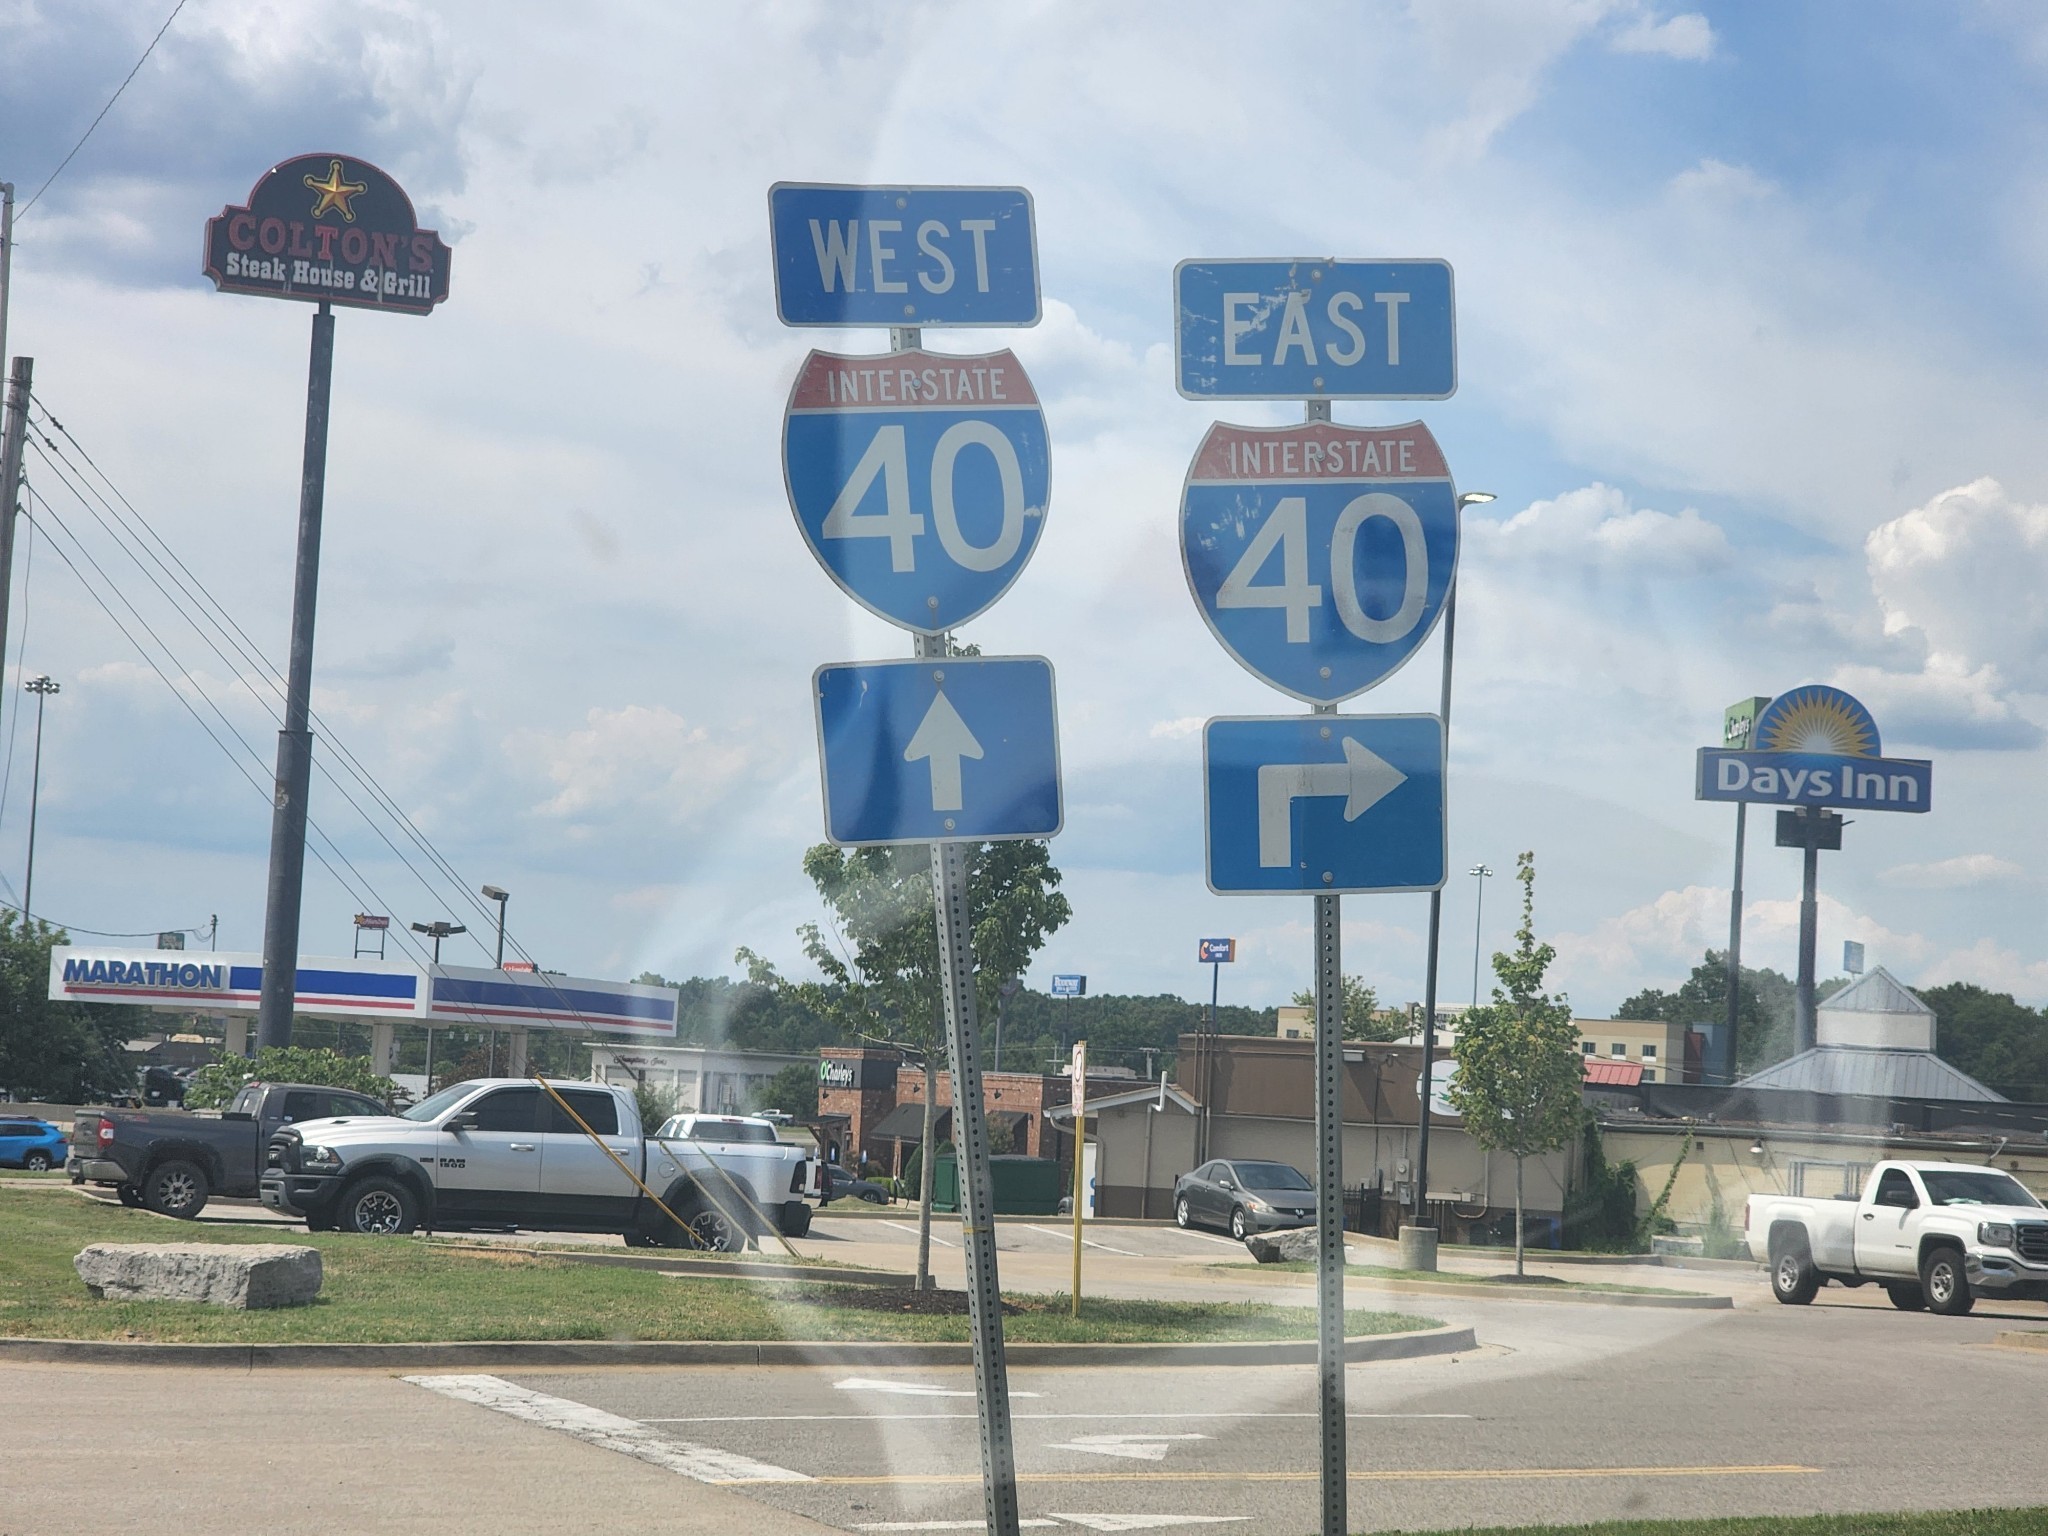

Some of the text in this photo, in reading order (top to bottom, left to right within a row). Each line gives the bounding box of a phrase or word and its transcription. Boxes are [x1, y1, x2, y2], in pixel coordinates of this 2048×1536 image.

[228, 213, 434, 273] COLTON'S
[808, 219, 996, 294] WEST
[226, 252, 431, 299] Steak House & Grill
[1223, 291, 1411, 367] EAST
[828, 369, 1007, 402] INTERSTATE
[1231, 441, 1417, 473] INTERSTATE
[822, 420, 1025, 572] 40
[1216, 493, 1429, 644] 40
[1718, 758, 1918, 802] Days Inn
[1210, 944, 1228, 952] Comfort
[63, 959, 222, 989] MARATHON
